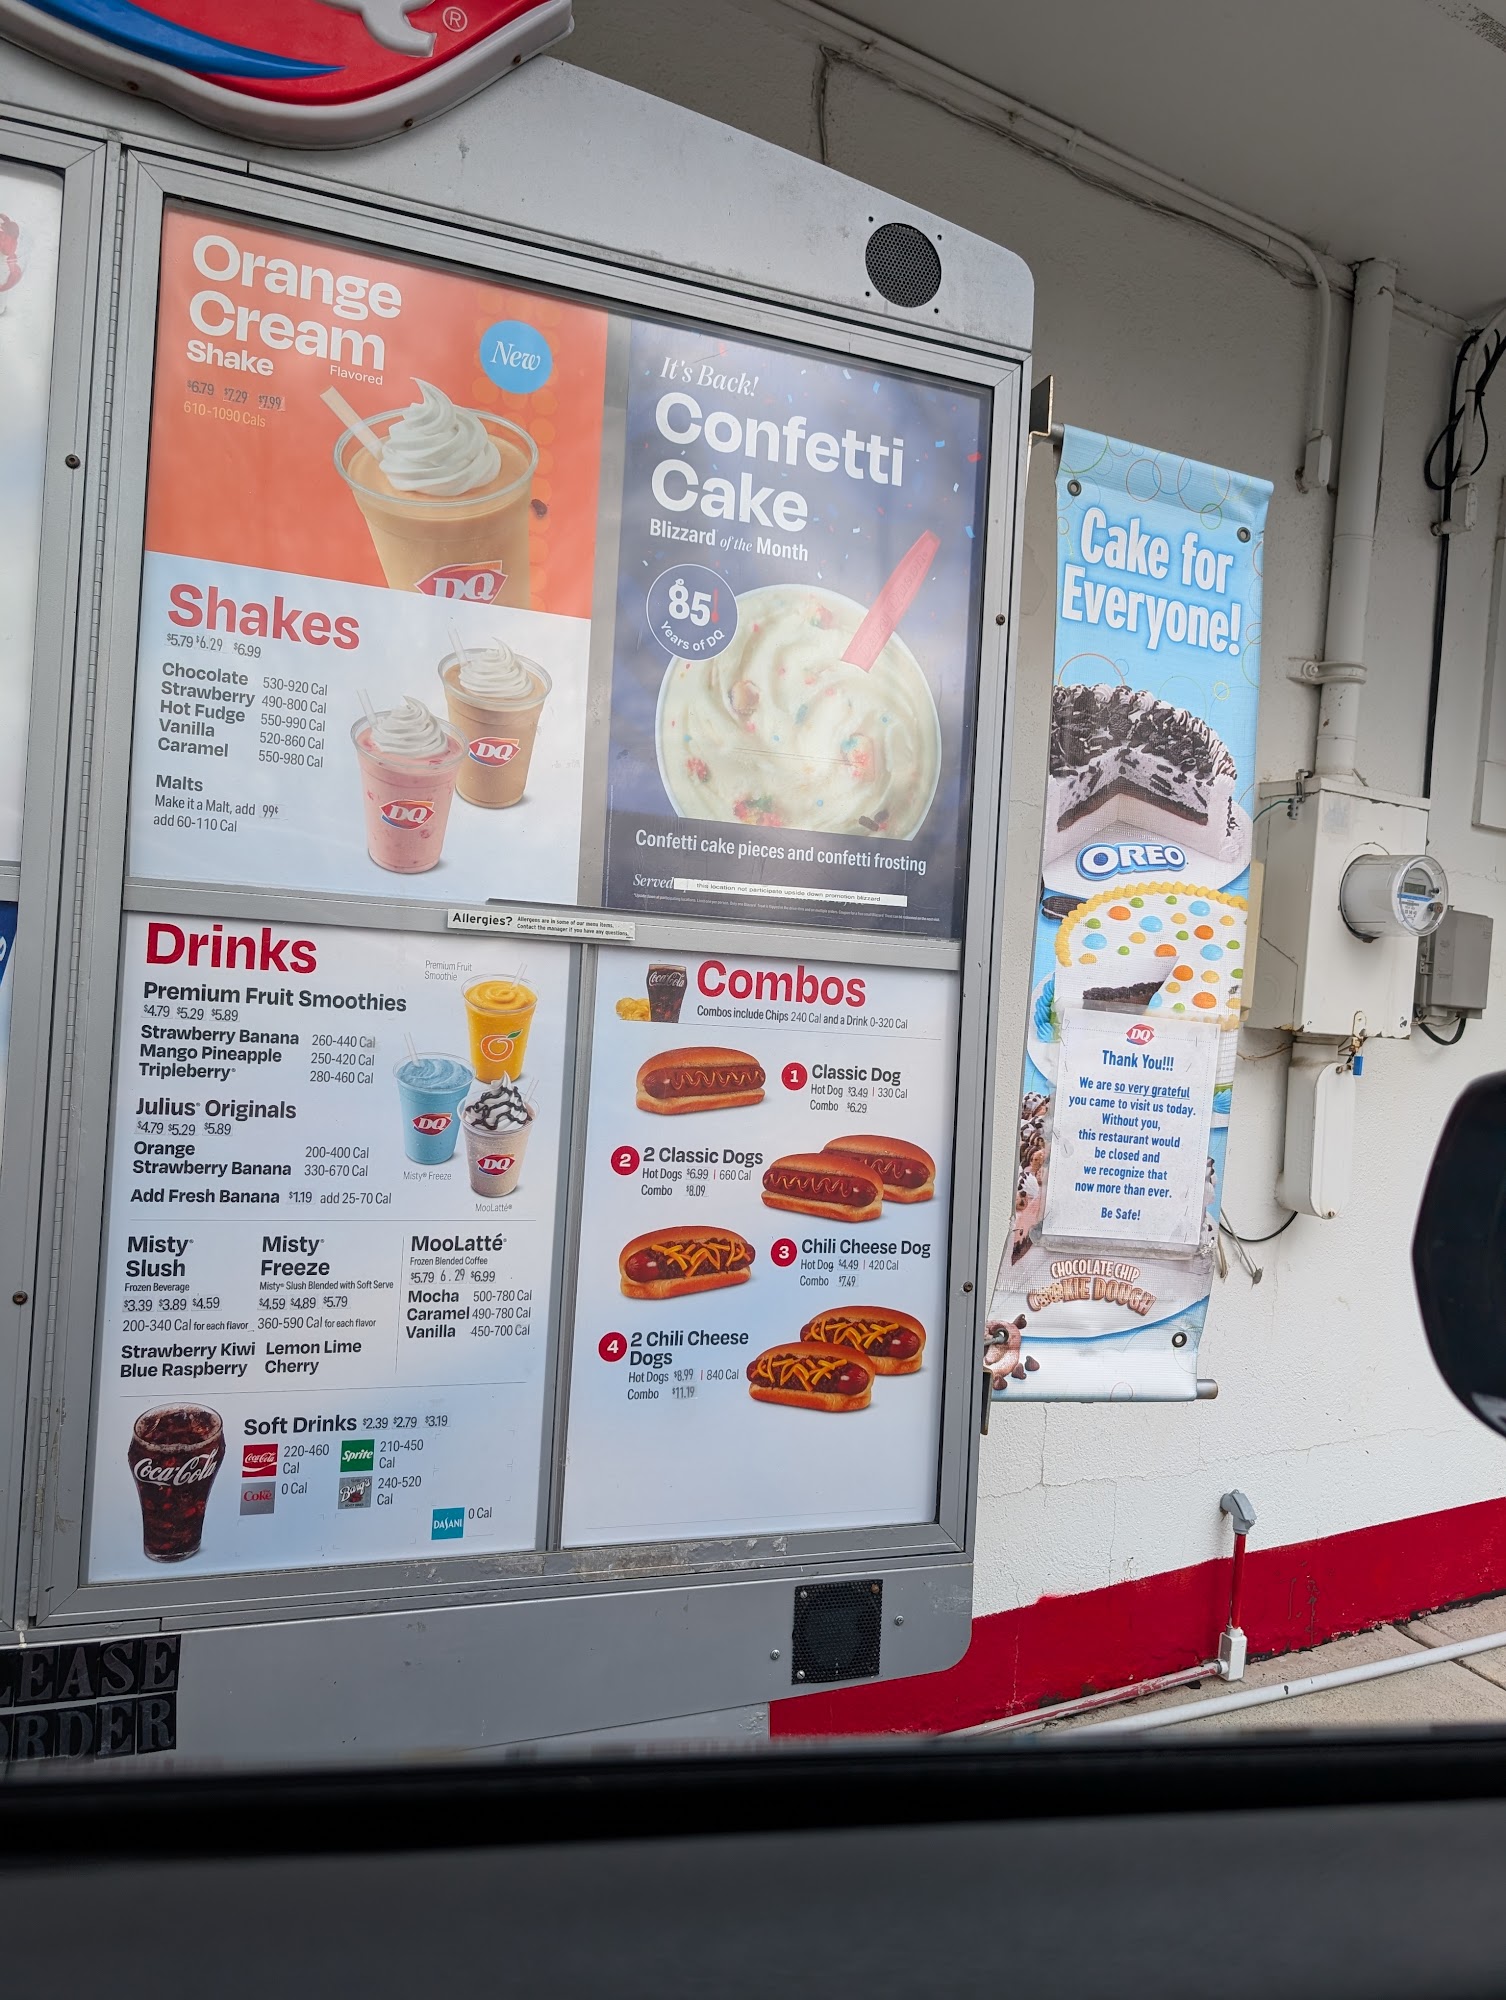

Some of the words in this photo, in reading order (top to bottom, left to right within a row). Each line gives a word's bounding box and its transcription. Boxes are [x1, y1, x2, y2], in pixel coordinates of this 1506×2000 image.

[192, 234, 401, 321] Orange
[189, 291, 385, 370] Cream
[187, 340, 273, 376] Shake
[490, 341, 540, 371] New
[330, 365, 383, 386] Flavored
[660, 357, 692, 383] It's
[696, 365, 759, 396] Back!
[183, 401, 240, 422] 610-1090
[242, 411, 265, 427] Cals
[656, 392, 903, 487] Confetti
[652, 459, 808, 531] Cake
[651, 519, 716, 545] Blizzard
[720, 536, 733, 548] of
[734, 537, 752, 552] the
[757, 537, 808, 561] Month
[1081, 508, 1169, 579] Cake
[1182, 532, 1234, 593] for
[668, 583, 712, 626] 85
[1062, 564, 1241, 656] Everyone!
[167, 583, 359, 649] Shakes
[661, 621, 691, 650] Years
[693, 637, 705, 651] of
[707, 628, 725, 649] DQ
[162, 662, 248, 686] Chocolate
[263, 677, 309, 694] 530-920
[161, 681, 255, 706] Strawberry
[262, 695, 308, 713] 490-800
[160, 700, 190, 716] Hot
[195, 704, 245, 724] Fudge
[260, 713, 306, 731] 550-990
[159, 719, 215, 737] Vanilla
[259, 732, 305, 749] 520-860
[158, 738, 228, 757] Caramel
[258, 750, 304, 767] 550-980
[476, 742, 513, 760] DQ
[156, 775, 203, 792] Malts
[155, 795, 183, 809] Make
[235, 802, 255, 816] add
[389, 806, 427, 823] DQ
[154, 815, 174, 828] add
[177, 816, 217, 830] 60-110
[220, 818, 236, 832] Cal
[635, 829, 697, 851] Confetti
[701, 838, 735, 855] cake
[738, 842, 785, 860] pieces
[788, 846, 814, 862] and
[817, 850, 871, 868] confetti
[874, 855, 927, 876] frosting
[1083, 845, 1184, 874] OREO
[633, 874, 674, 890] Served
[710, 884, 734, 892] location
[784, 889, 805, 897] upside
[824, 892, 855, 900] promotion
[856, 894, 881, 902] blizzard
[453, 912, 513, 926] Allergies?
[146, 922, 317, 974] Drinks
[697, 958, 866, 1007] Combos
[143, 981, 240, 1004] Premium
[246, 987, 293, 1006] Fruit
[298, 990, 407, 1012] Smoothies
[143, 1004, 170, 1018] $4.79
[177, 1006, 204, 1020] $5.29
[211, 1008, 238, 1022] $5.89
[697, 1005, 731, 1018] Combos
[733, 1008, 764, 1020] include
[766, 1009, 788, 1022] Chips
[847, 1015, 868, 1027] Drink
[140, 1025, 236, 1045] Strawberry
[239, 1030, 299, 1045] Banana
[311, 1033, 357, 1048] 260-440
[1130, 1028, 1151, 1041] DQ
[139, 1044, 198, 1061] Mango
[201, 1048, 282, 1065] Pineapple
[310, 1052, 356, 1066] 250-420
[1102, 1050, 1138, 1068] Thank
[1142, 1055, 1174, 1071] You!!!
[310, 1070, 355, 1084] 280-460
[811, 1064, 867, 1081] Classic
[871, 1068, 901, 1085] Dog
[1151, 1085, 1190, 1100] grateful
[205, 1099, 297, 1122] Originals
[1166, 1101, 1196, 1116] today.
[137, 1120, 164, 1135] $4.79
[168, 1123, 196, 1136] $5.29
[204, 1122, 231, 1136] $5.89
[417, 1117, 447, 1130] DQ
[1102, 1113, 1138, 1126] Without
[1098, 1131, 1148, 1145] restaurant
[133, 1141, 195, 1158] Orange
[305, 1146, 351, 1159] 200-400
[659, 1149, 718, 1164] Classic
[723, 1150, 763, 1167] Dogs
[1108, 1148, 1139, 1162] closed
[132, 1160, 228, 1178] Strawberry
[231, 1162, 292, 1176] Banana
[304, 1164, 350, 1177] 330-670
[481, 1158, 512, 1171] DQ
[1098, 1165, 1145, 1180] recognize
[130, 1189, 165, 1203] Add
[168, 1189, 215, 1203] Fresh
[219, 1189, 280, 1203] Banana
[342, 1192, 373, 1205] 25-70
[1115, 1208, 1141, 1221] Safe!
[802, 1238, 836, 1254] Chili
[839, 1240, 897, 1255] Cheese
[901, 1241, 931, 1258] Dog
[125, 1259, 185, 1278] Slush
[260, 1259, 330, 1276] Freeze
[1051, 1259, 1114, 1279] CHOCOLATE
[1114, 1262, 1140, 1283] CHIP
[153, 1283, 190, 1293] Beverage
[408, 1289, 459, 1303] Mocha
[473, 1290, 515, 1302] 500-780
[1092, 1278, 1157, 1316] DOUGH
[124, 1299, 153, 1312] $3.39
[159, 1298, 187, 1311] $3.89
[407, 1306, 470, 1321] Caramel
[472, 1307, 514, 1319] 490-780
[123, 1319, 172, 1332] 200-340
[257, 1317, 304, 1329] 360-590
[406, 1324, 456, 1338] Vanilla
[266, 1342, 320, 1355] Lemon
[324, 1340, 362, 1354] Lime
[646, 1332, 684, 1347] Chili
[688, 1331, 749, 1346] Cheese
[121, 1343, 217, 1360] Strawberry
[220, 1341, 256, 1357] Kiwi
[630, 1351, 672, 1369] Dogs
[120, 1363, 158, 1378] Blue
[162, 1361, 248, 1378] Raspberry
[265, 1359, 319, 1375] Cherry
[243, 1418, 288, 1435] Soft
[293, 1415, 358, 1433] Drinks
[284, 1444, 330, 1457] 220-460
[342, 1450, 373, 1463] Sprite
[379, 1439, 424, 1453] 210-450
[134, 1448, 219, 1487] Coca-Cola
[244, 1490, 272, 1501] Coke
[340, 1479, 371, 1502] Barq's
[378, 1476, 421, 1489] 240-520
[434, 1517, 462, 1530] DASANI
[0, 1637, 177, 1705] EASE
